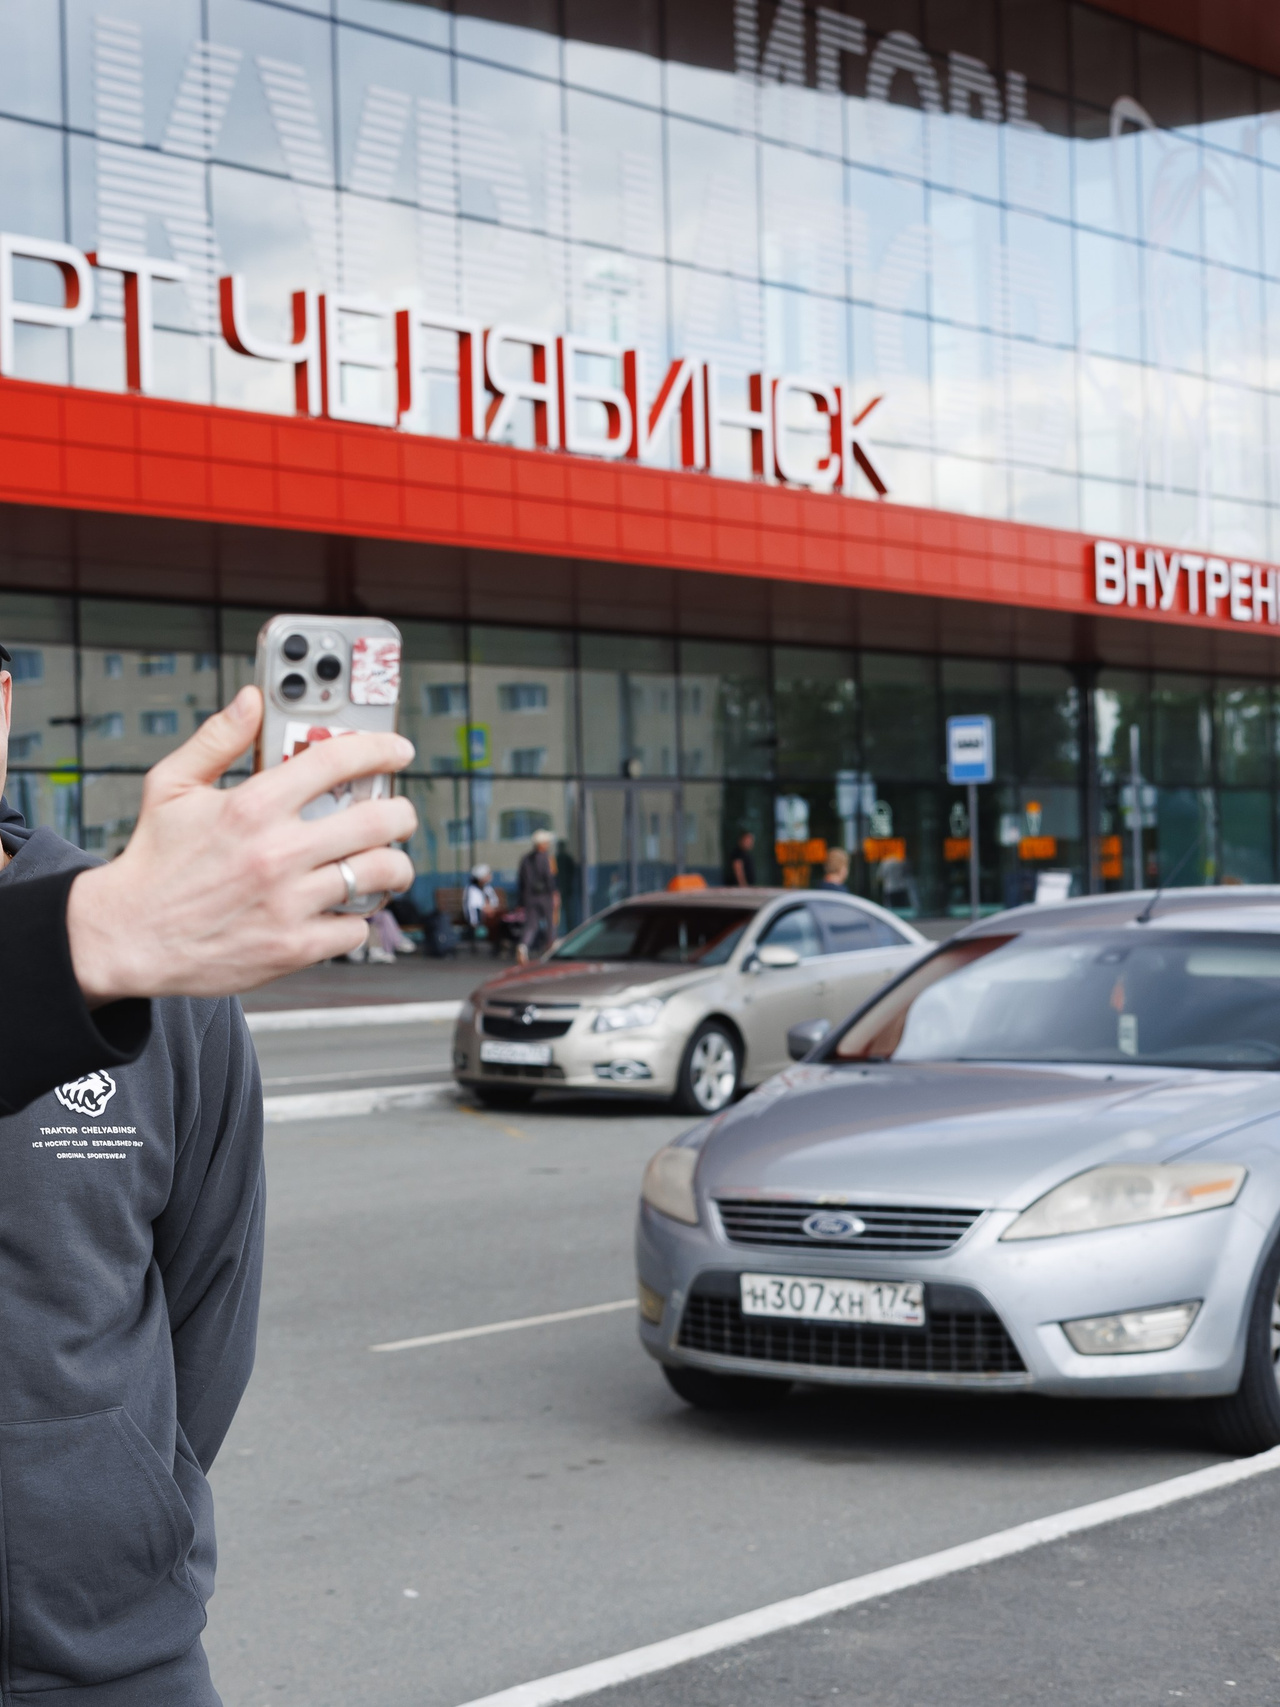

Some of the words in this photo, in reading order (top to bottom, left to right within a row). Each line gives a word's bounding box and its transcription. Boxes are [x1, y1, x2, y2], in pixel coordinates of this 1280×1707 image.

[219, 271, 891, 499] ЧЕЛЯБИНСК
[1093, 539, 1280, 626] ВНУТРЕН
[40, 1126, 78, 1135] TRAKTOR
[81, 1126, 136, 1134] CHELYABINSK
